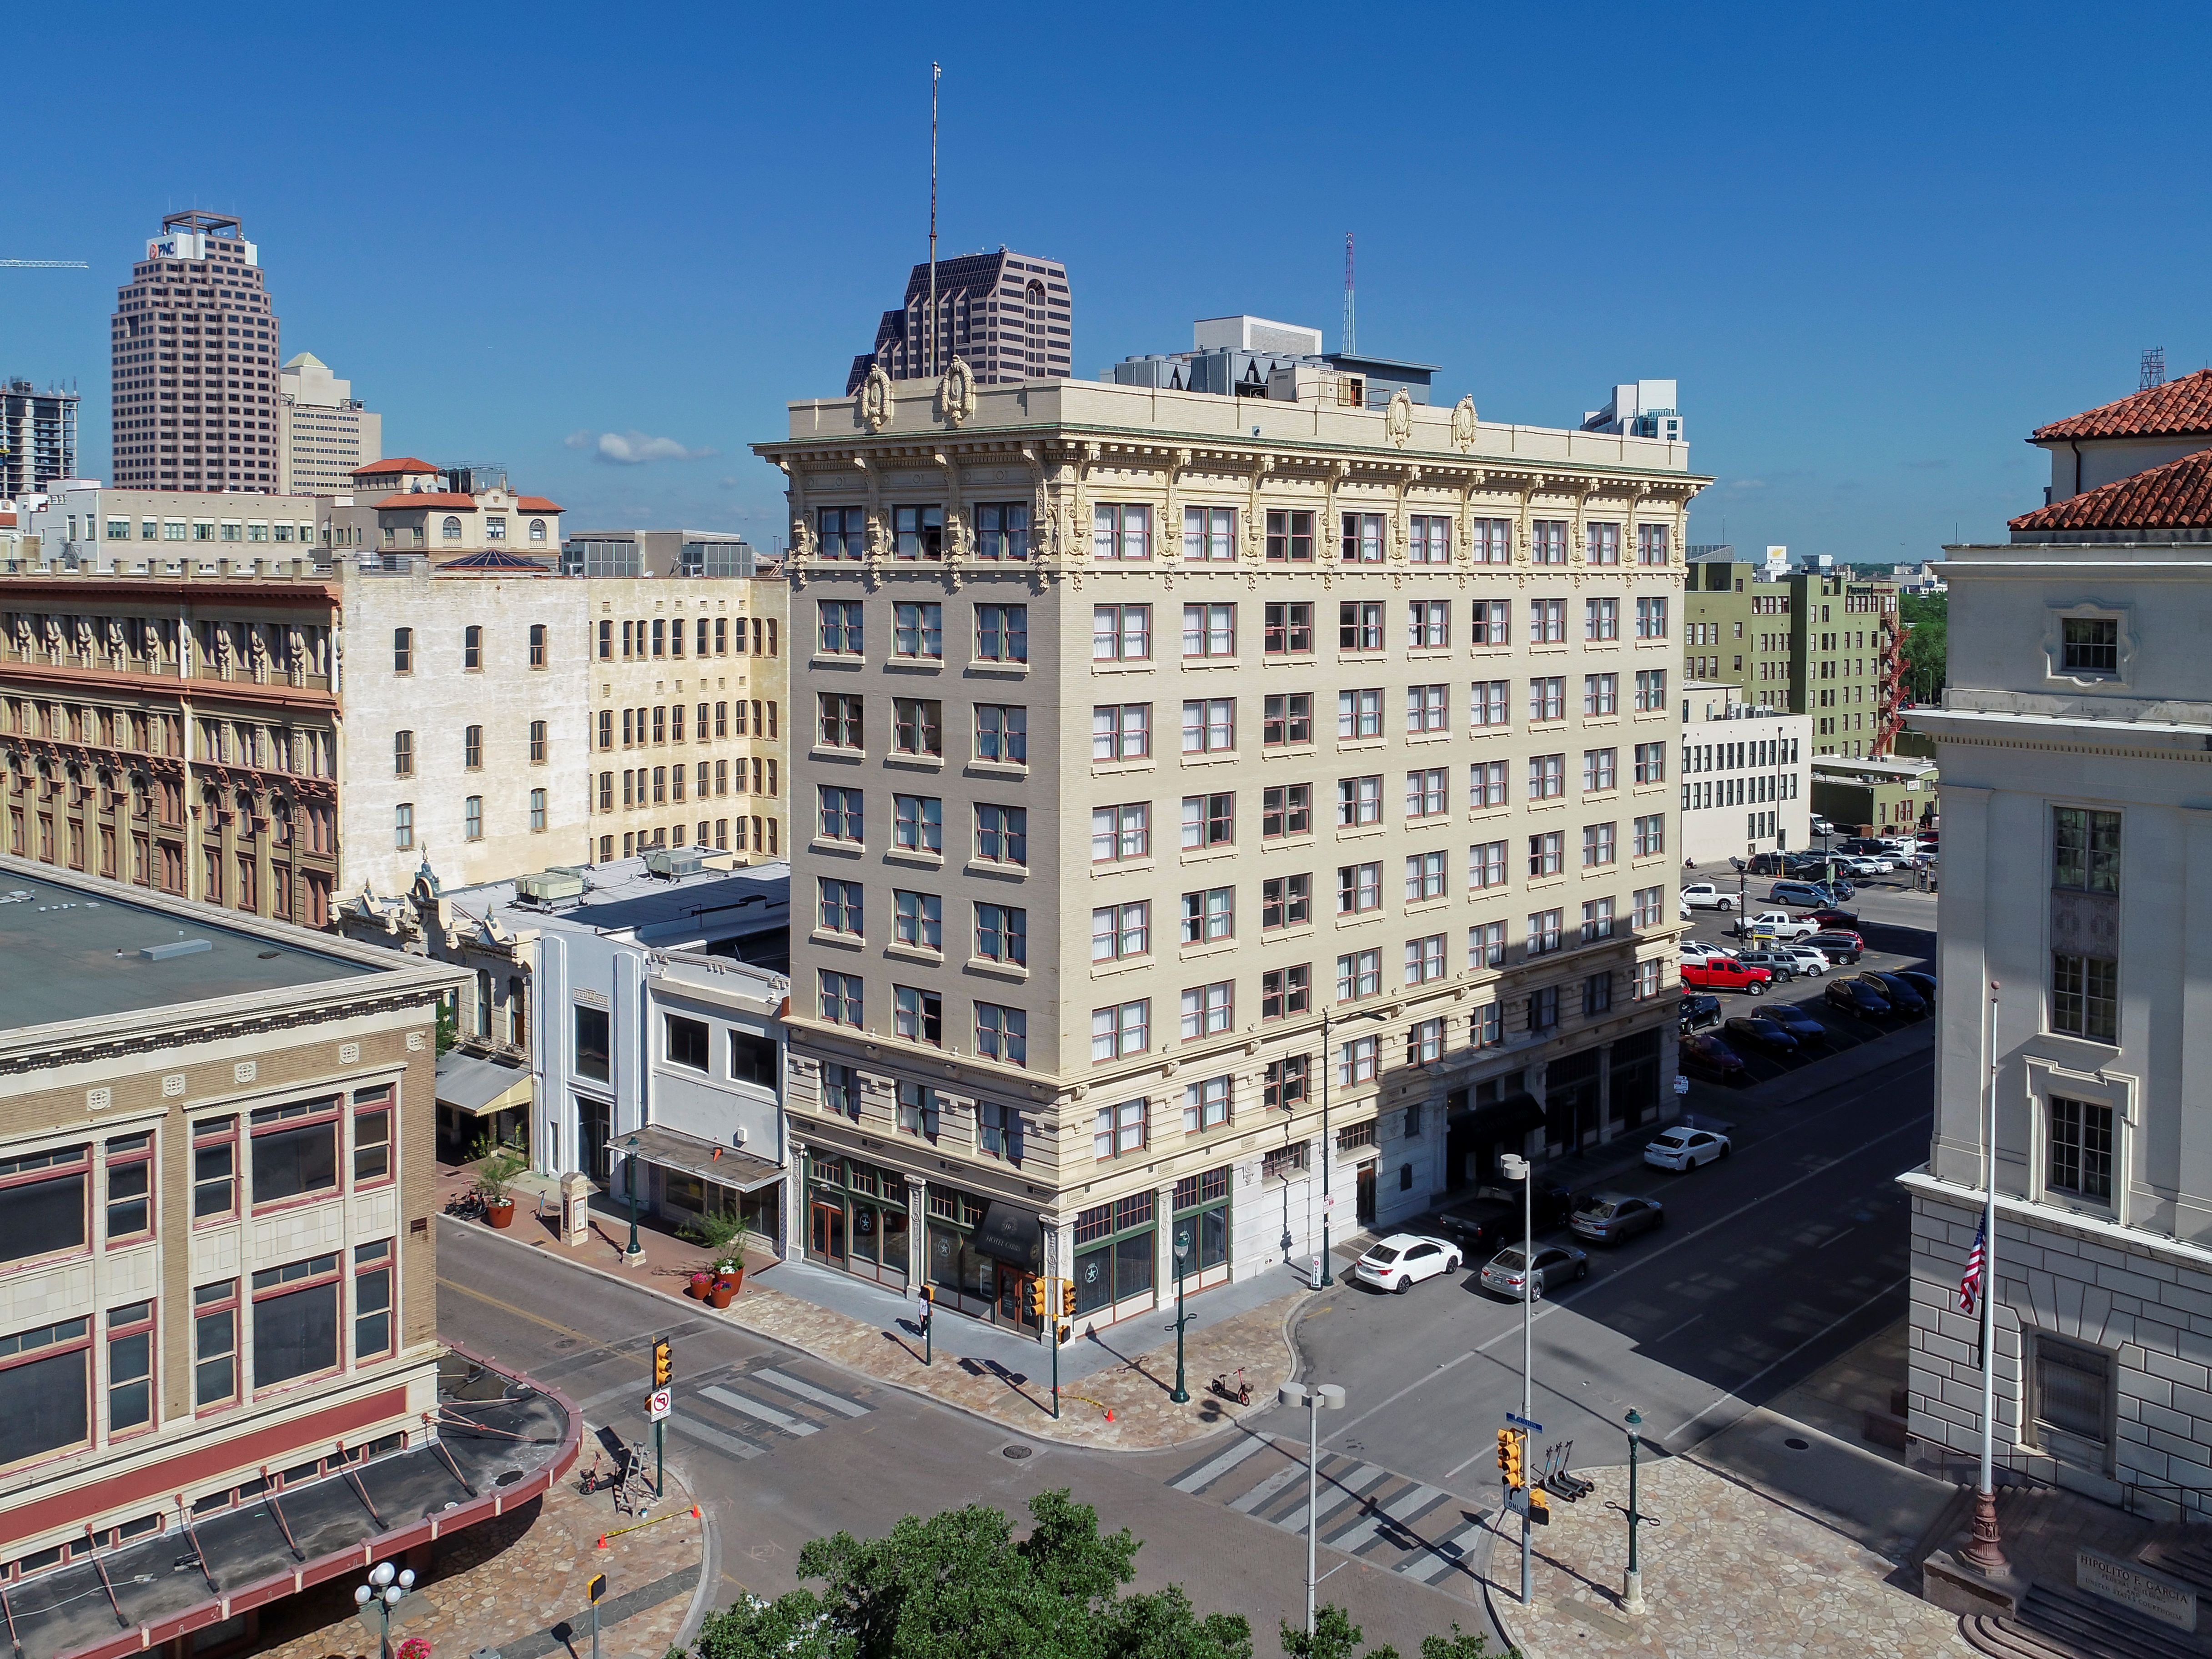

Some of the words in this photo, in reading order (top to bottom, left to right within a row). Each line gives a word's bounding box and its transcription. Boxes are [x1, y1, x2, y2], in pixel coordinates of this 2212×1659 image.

[158, 241, 174, 257] PNC
[1319, 369, 1347, 377] GENERAC
[986, 1236, 1004, 1247] HOTEL
[1005, 1242, 1020, 1252] GIBBS
[1508, 1501, 1523, 1513] ONLY
[2081, 1554, 2130, 1580] HIPOLITO
[2146, 1580, 2188, 1604] GARCIA
[2102, 1574, 2130, 1589] FEDERAL
[2085, 1577, 2111, 1591] UNITED
[2113, 1589, 2136, 1603] STATES
[2138, 1599, 2183, 1621] COURTHOUSE
[2127, 1589, 2140, 1598] AND
